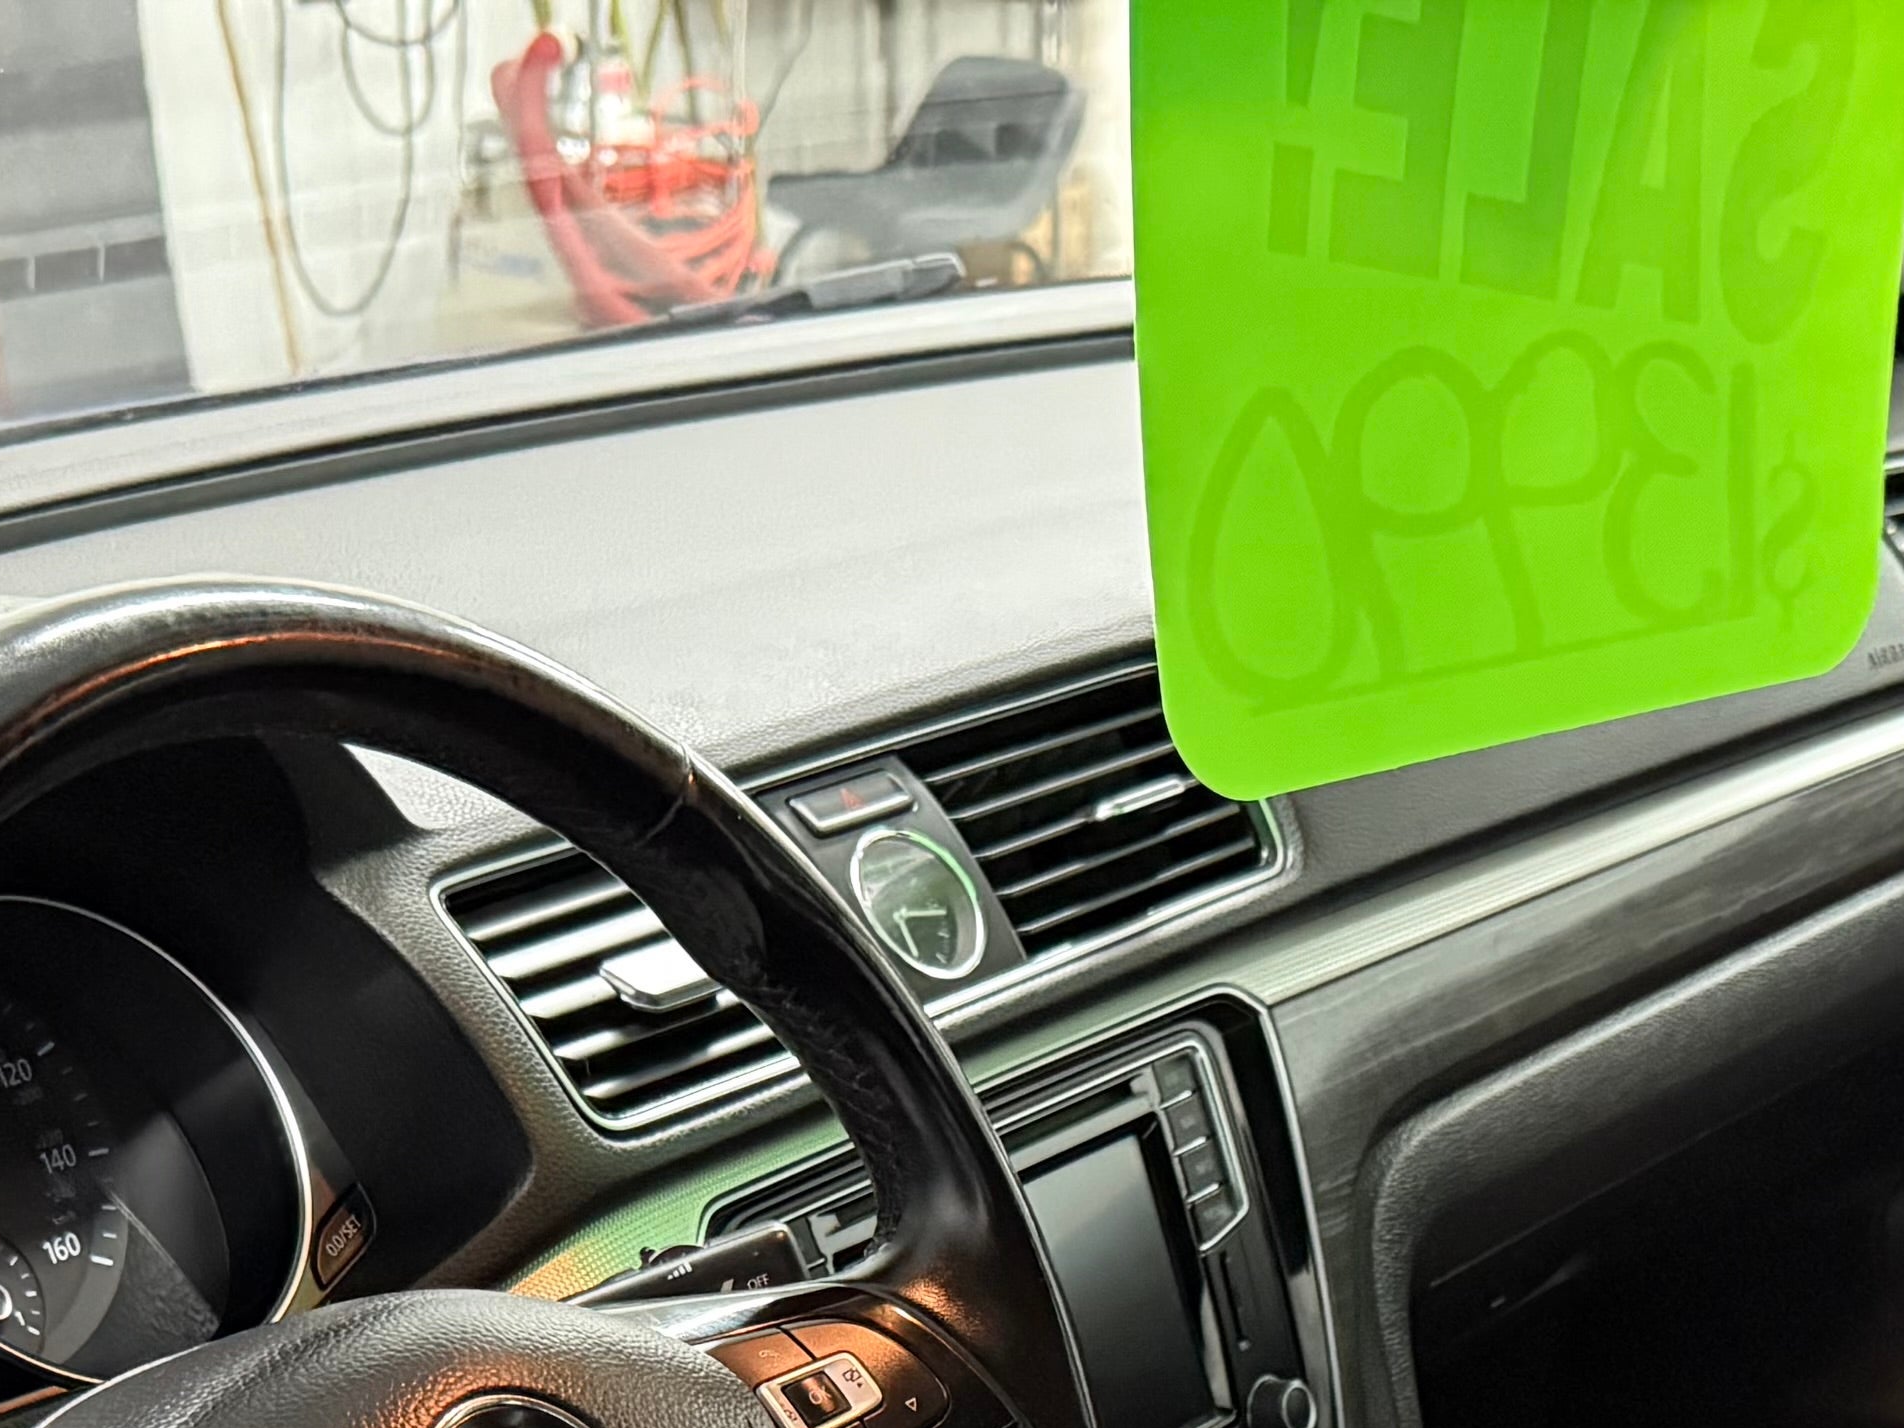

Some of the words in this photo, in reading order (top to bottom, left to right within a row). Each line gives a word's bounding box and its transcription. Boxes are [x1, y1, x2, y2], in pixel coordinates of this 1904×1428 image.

[39, 1143, 77, 1175] 140
[41, 1231, 82, 1266] 160
[746, 1272, 771, 1291] OFF
